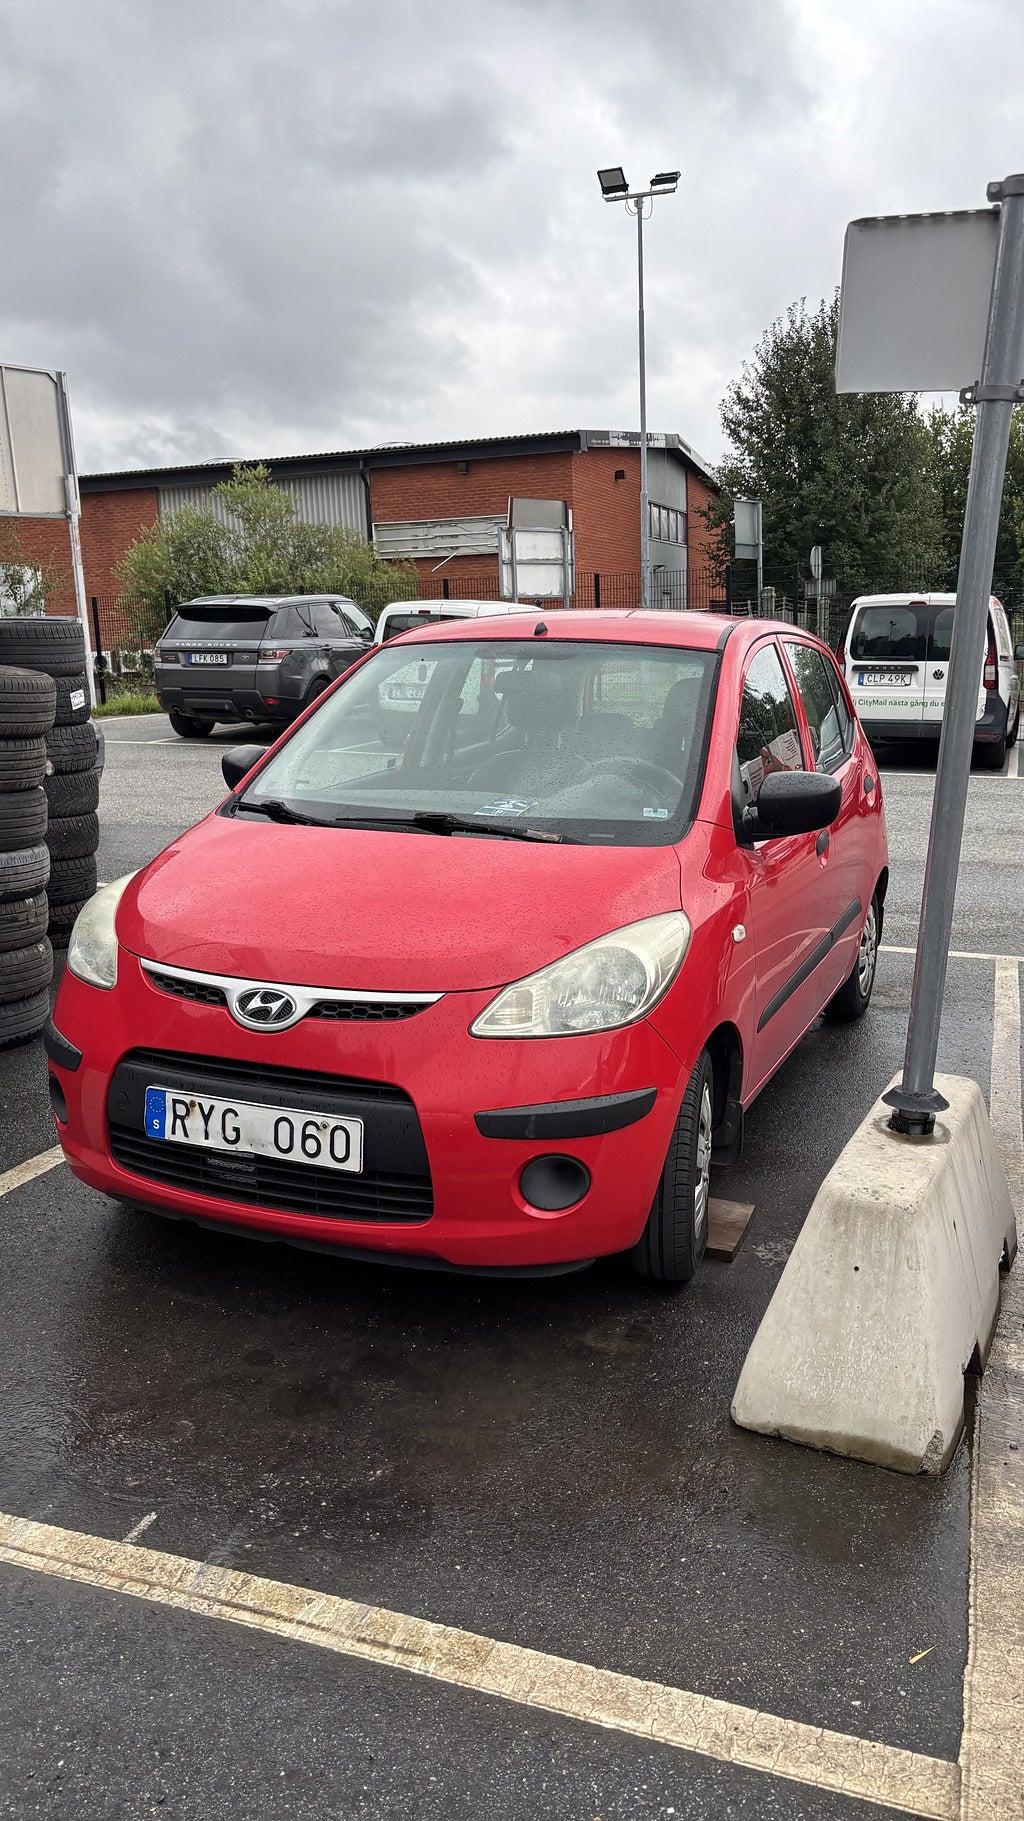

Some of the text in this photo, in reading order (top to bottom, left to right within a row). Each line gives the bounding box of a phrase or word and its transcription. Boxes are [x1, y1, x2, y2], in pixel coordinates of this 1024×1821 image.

[194, 654, 225, 663] LFK 085
[867, 674, 907, 683] CLP 49K
[858, 698, 888, 707] CityMail
[888, 698, 909, 706] nästa
[909, 699, 929, 708] gång
[152, 1118, 160, 1130] S
[170, 1098, 351, 1163] RYG 060
